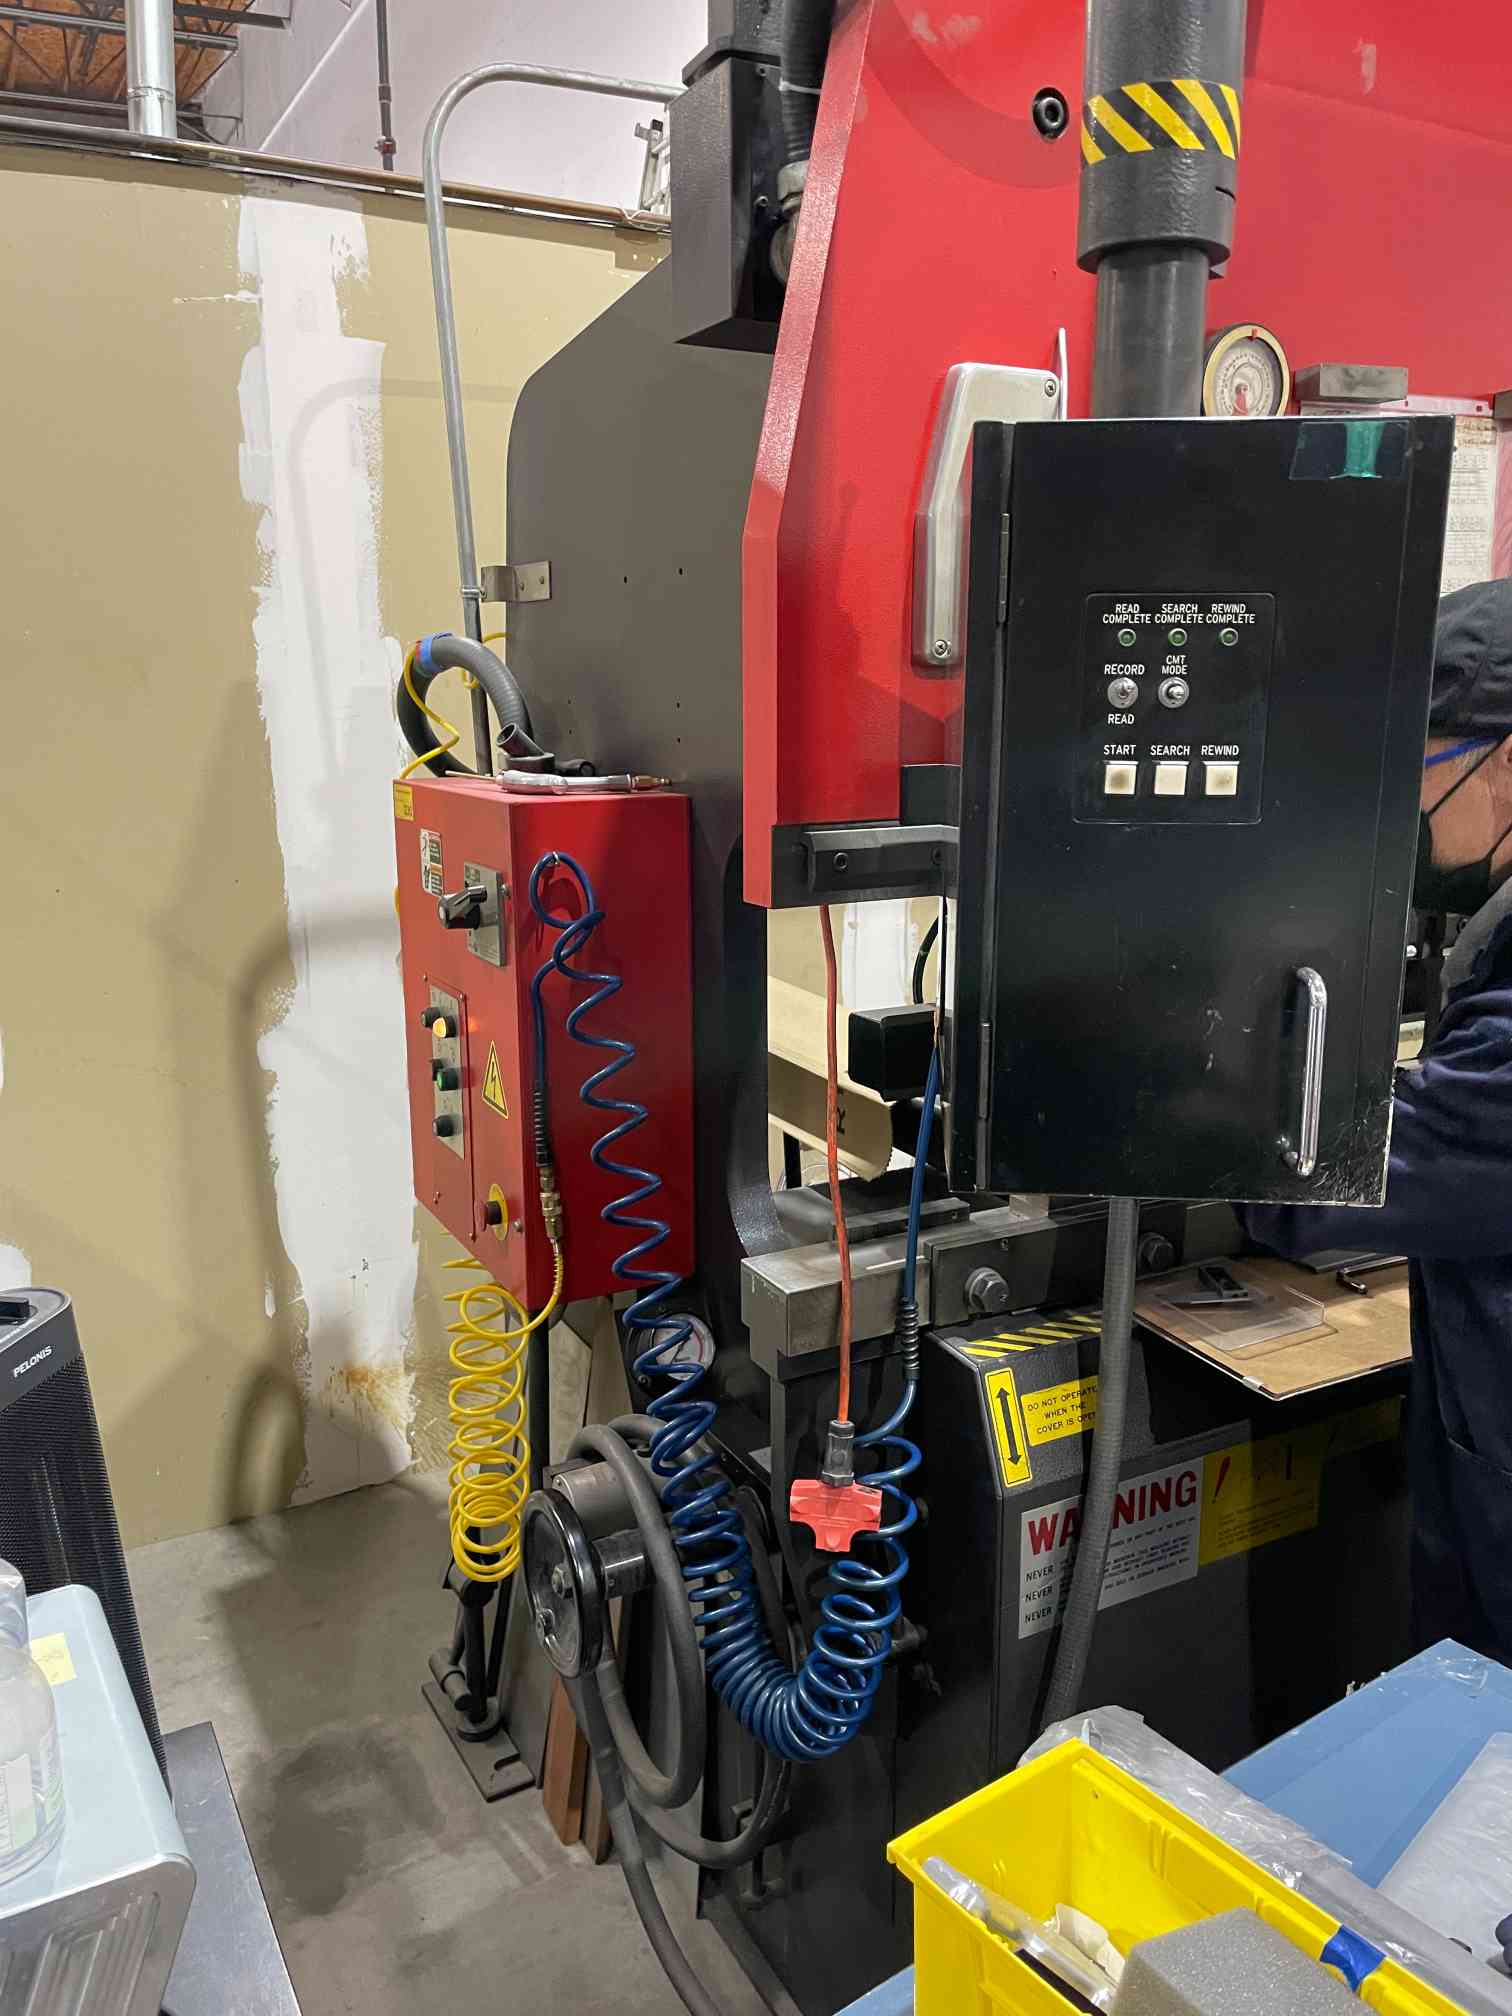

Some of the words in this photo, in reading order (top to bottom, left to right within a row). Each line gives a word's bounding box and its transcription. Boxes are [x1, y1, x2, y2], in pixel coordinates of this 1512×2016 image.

[1115, 603, 1140, 614] READ
[1161, 603, 1198, 614] SEARCH
[1211, 603, 1246, 614] REWIND
[1102, 613, 1151, 624] COMPLETE
[1154, 613, 1204, 624] COMPLETE
[1206, 613, 1255, 624] COMPLETE
[1165, 655, 1186, 665] CMT
[1104, 664, 1145, 675] RECORD
[1161, 665, 1188, 675] MODE
[1107, 713, 1135, 725] READ
[1103, 744, 1137, 756] START
[1150, 745, 1191, 756] SEARCH
[1200, 745, 1240, 756] REWIND
[13, 1346, 52, 1378] PELONIS
[1027, 1402, 1039, 1411] DO
[1041, 1397, 1057, 1407] NOT
[1044, 1408, 1068, 1419] WHEN
[1071, 1401, 1086, 1411] THE
[1037, 1421, 1064, 1434] COVER
[1066, 1417, 1075, 1425] IS
[1027, 1470, 1198, 1556] WANING
[1025, 1564, 1055, 1583] NEVER
[1024, 1585, 1054, 1603] NEVER
[1024, 1606, 1052, 1624] NEVER
